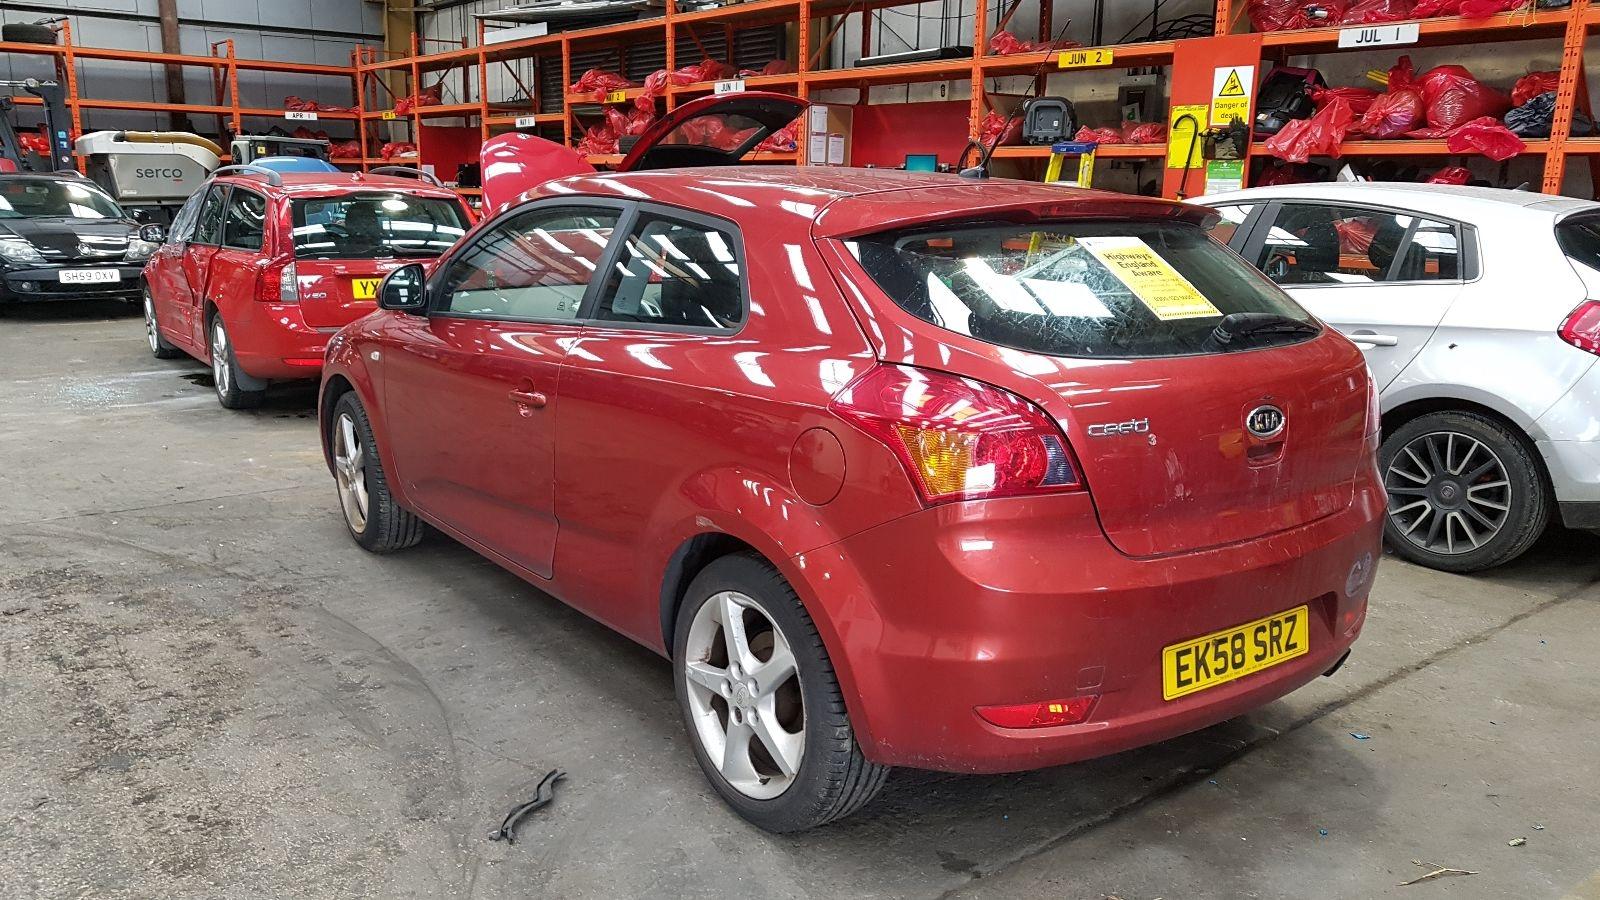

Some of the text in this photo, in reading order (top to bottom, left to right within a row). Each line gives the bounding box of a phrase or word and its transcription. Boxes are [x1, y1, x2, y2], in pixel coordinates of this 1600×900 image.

[1355, 27, 1400, 44] JUL 1
[1068, 51, 1102, 65] JUN 2
[720, 83, 732, 92] JUN
[1215, 102, 1238, 110] Danger
[1240, 100, 1248, 108] of
[136, 168, 183, 178] serco
[1103, 252, 1153, 263] Highways
[1117, 261, 1158, 271] England
[64, 271, 92, 281] SH59
[1132, 269, 1163, 277] Aware
[1253, 411, 1279, 431] KIA
[1176, 614, 1298, 689] EK58 SRZ
